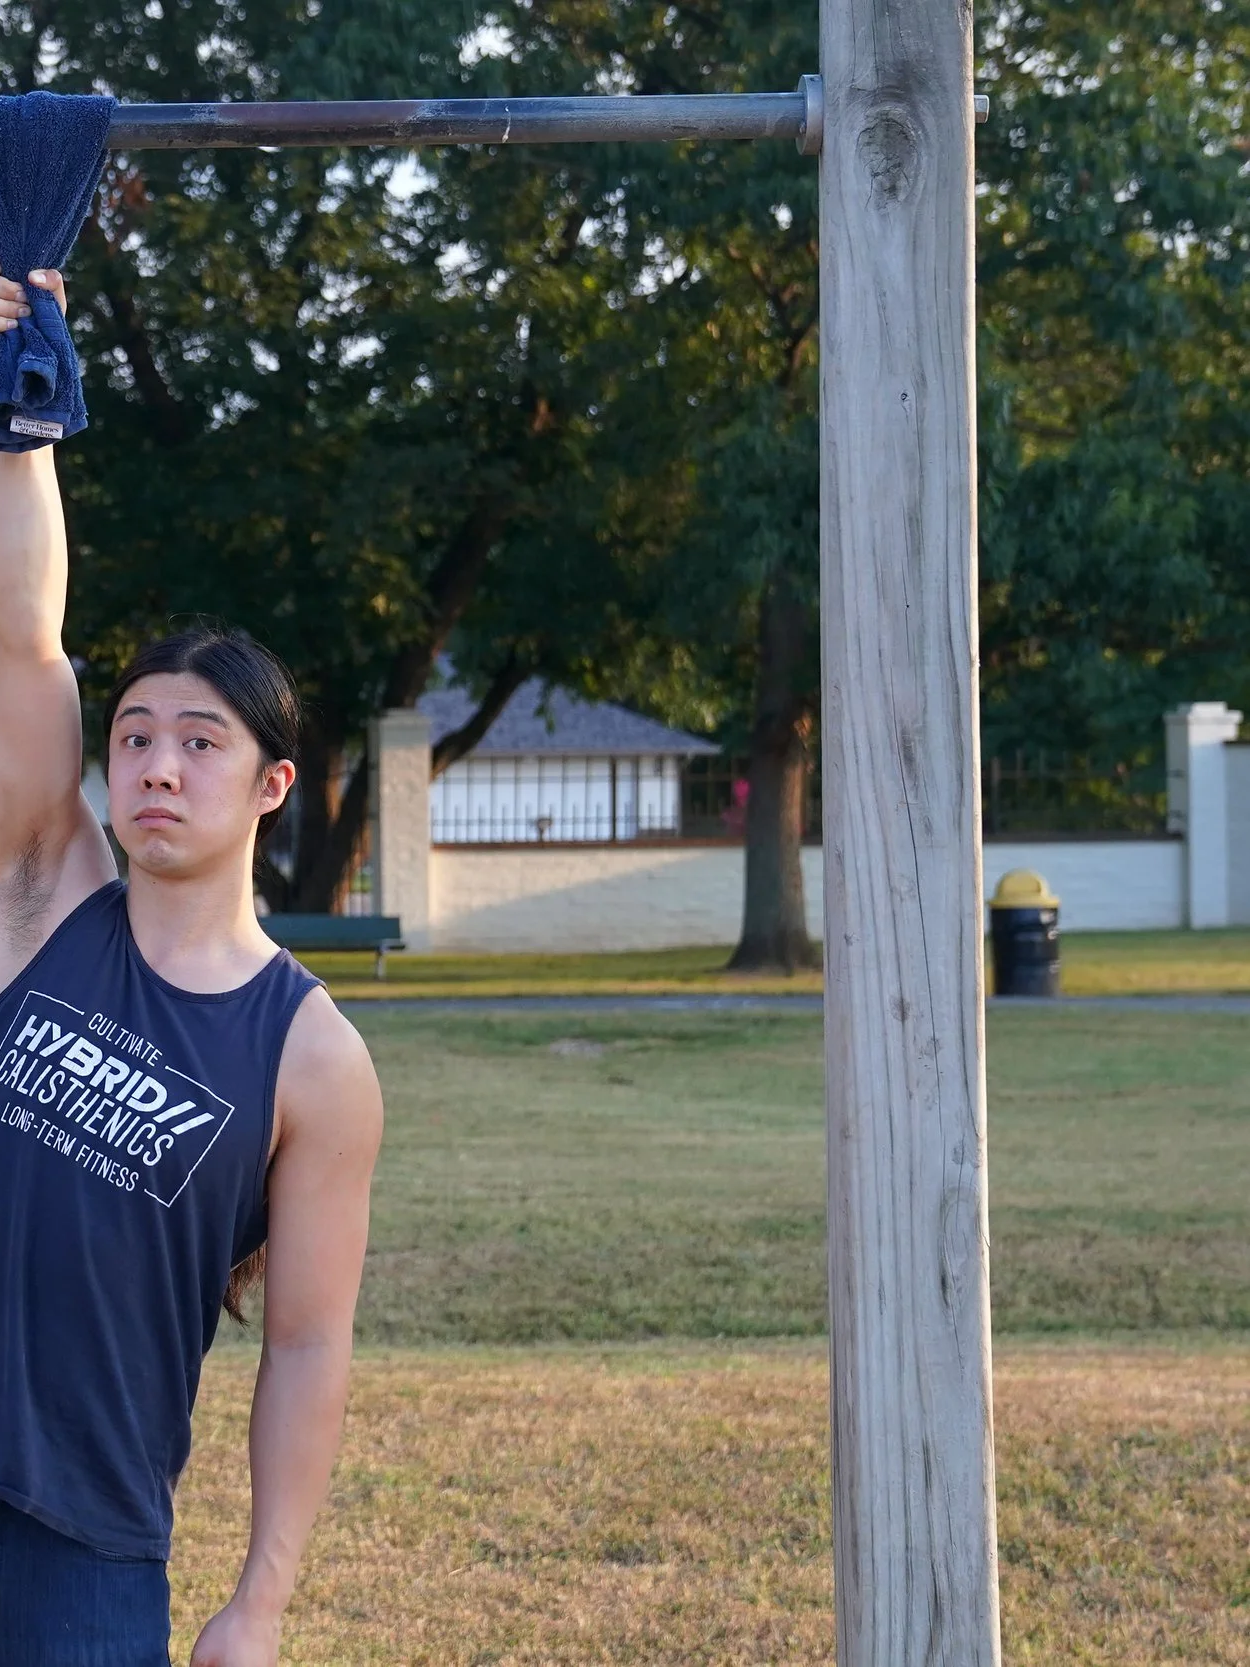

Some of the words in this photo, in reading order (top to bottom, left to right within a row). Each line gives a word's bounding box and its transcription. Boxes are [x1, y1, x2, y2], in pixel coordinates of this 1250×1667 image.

[15, 420, 35, 429] Better
[36, 424, 59, 432] Homes
[88, 1012, 163, 1067] CULTIVATE
[0, 1102, 76, 1157] LONG-TERM
[75, 1144, 139, 1192] FITNESS
